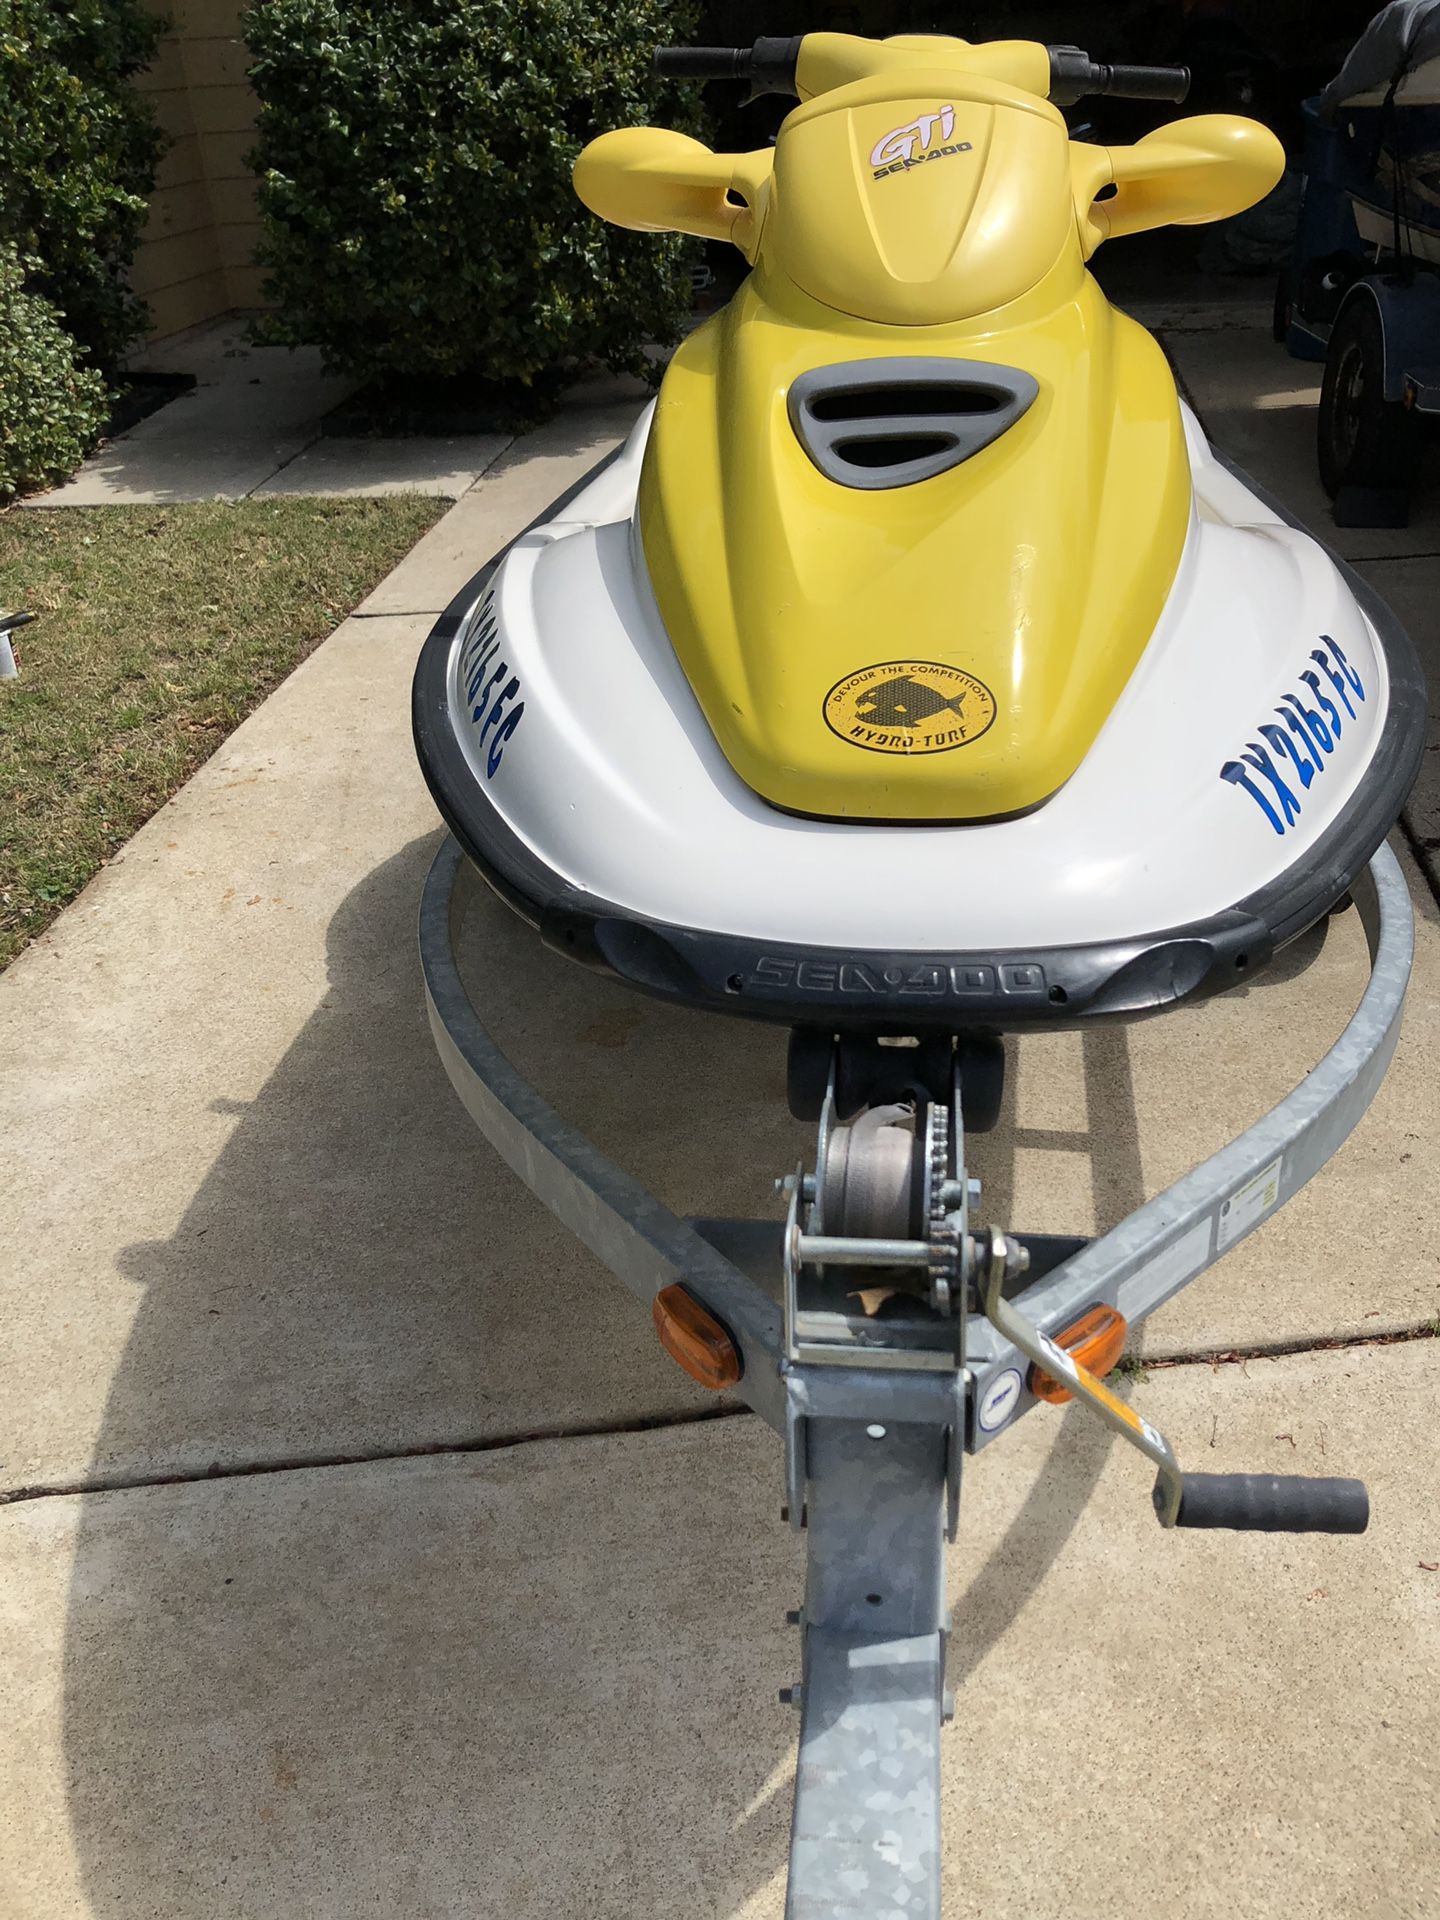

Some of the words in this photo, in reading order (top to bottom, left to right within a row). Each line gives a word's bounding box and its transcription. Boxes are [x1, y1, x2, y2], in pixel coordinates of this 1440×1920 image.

[833, 671, 876, 703] DEVOUR
[880, 665, 905, 675] THE
[910, 665, 988, 702] COMPETITION
[849, 725, 968, 748] HYDRO-TURF
